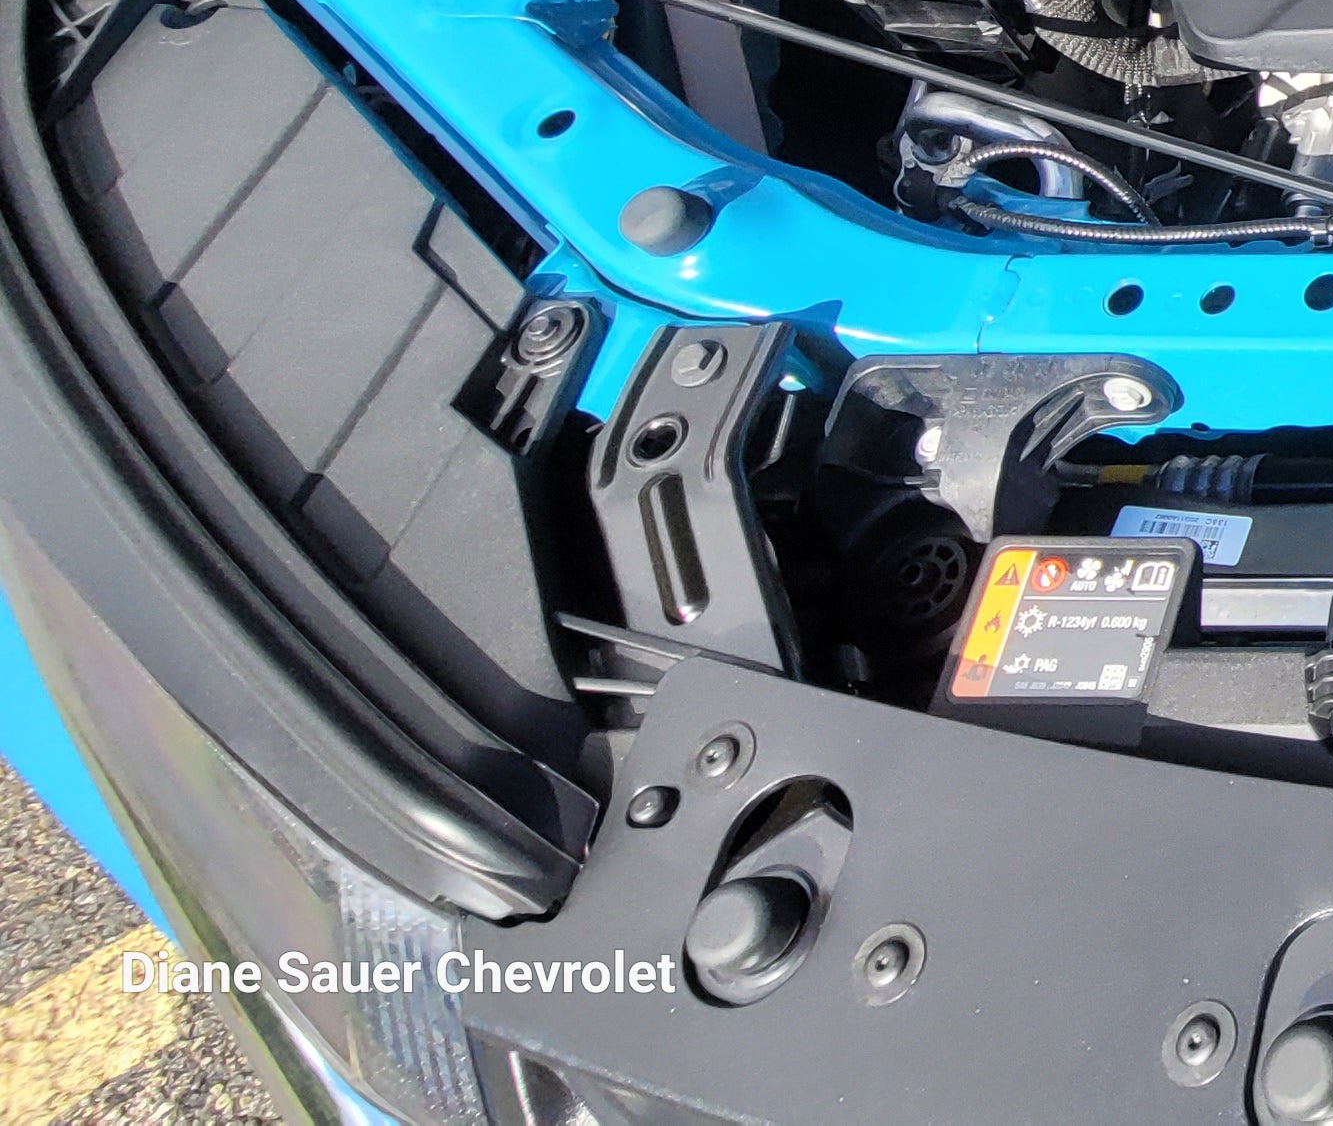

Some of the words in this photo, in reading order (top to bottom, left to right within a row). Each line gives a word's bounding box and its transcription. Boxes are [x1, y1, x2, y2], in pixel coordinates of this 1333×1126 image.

[1070, 580, 1097, 592] AUTO
[1047, 615, 1098, 631] R-1234yf
[1101, 615, 1133, 629] 0.600
[1133, 615, 1148, 631] kg
[1033, 658, 1059, 673] PAG
